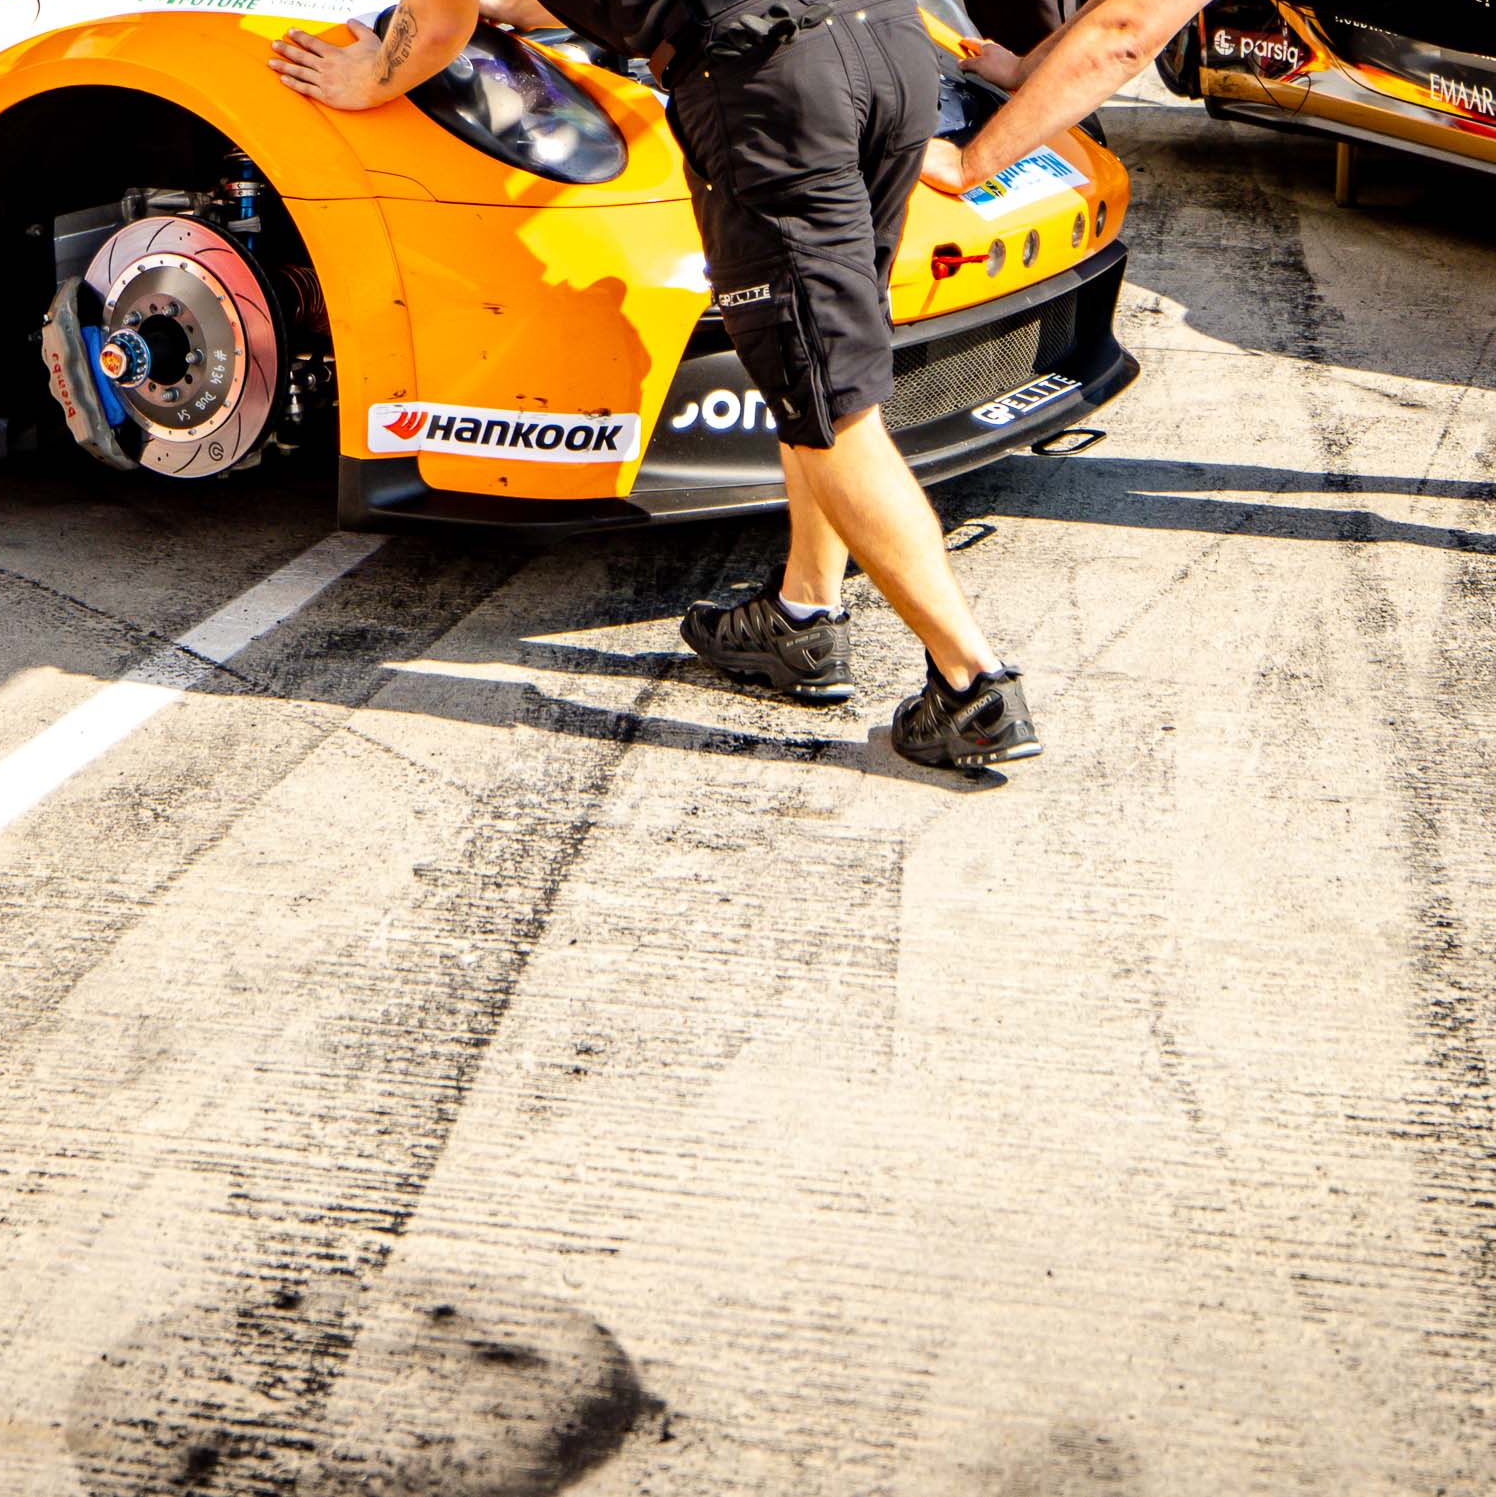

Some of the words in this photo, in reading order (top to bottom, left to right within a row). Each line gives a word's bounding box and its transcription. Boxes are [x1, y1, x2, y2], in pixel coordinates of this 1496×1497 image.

[1239, 36, 1300, 66] parsiq
[1429, 72, 1496, 118] EMAAR
[730, 283, 771, 305] ELITE
[970, 402, 1015, 427] GP
[1001, 372, 1082, 414] ELITE
[425, 412, 624, 453] HANKOOK
